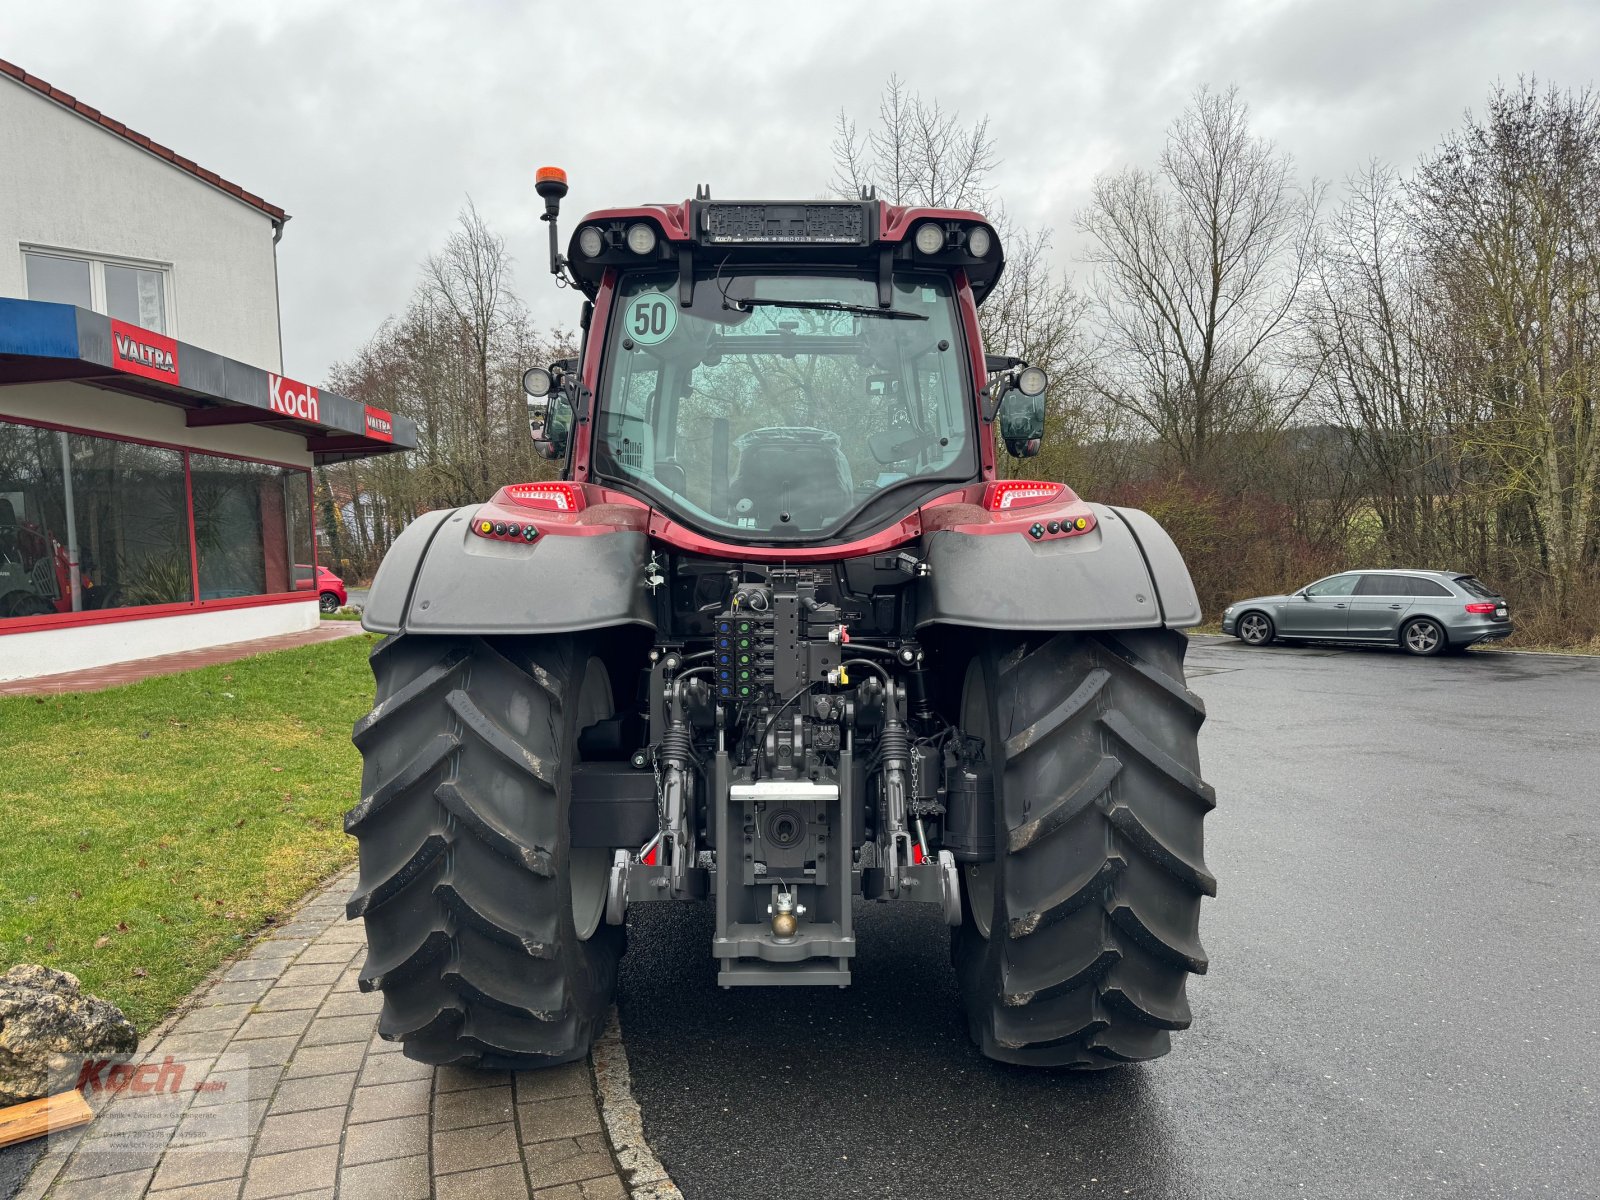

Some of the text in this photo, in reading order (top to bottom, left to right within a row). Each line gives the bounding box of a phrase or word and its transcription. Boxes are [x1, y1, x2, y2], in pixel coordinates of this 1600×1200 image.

[634, 301, 667, 336] 50
[113, 331, 177, 374] VALTRA
[268, 373, 319, 421] Koch
[366, 413, 392, 435] VALTRA
